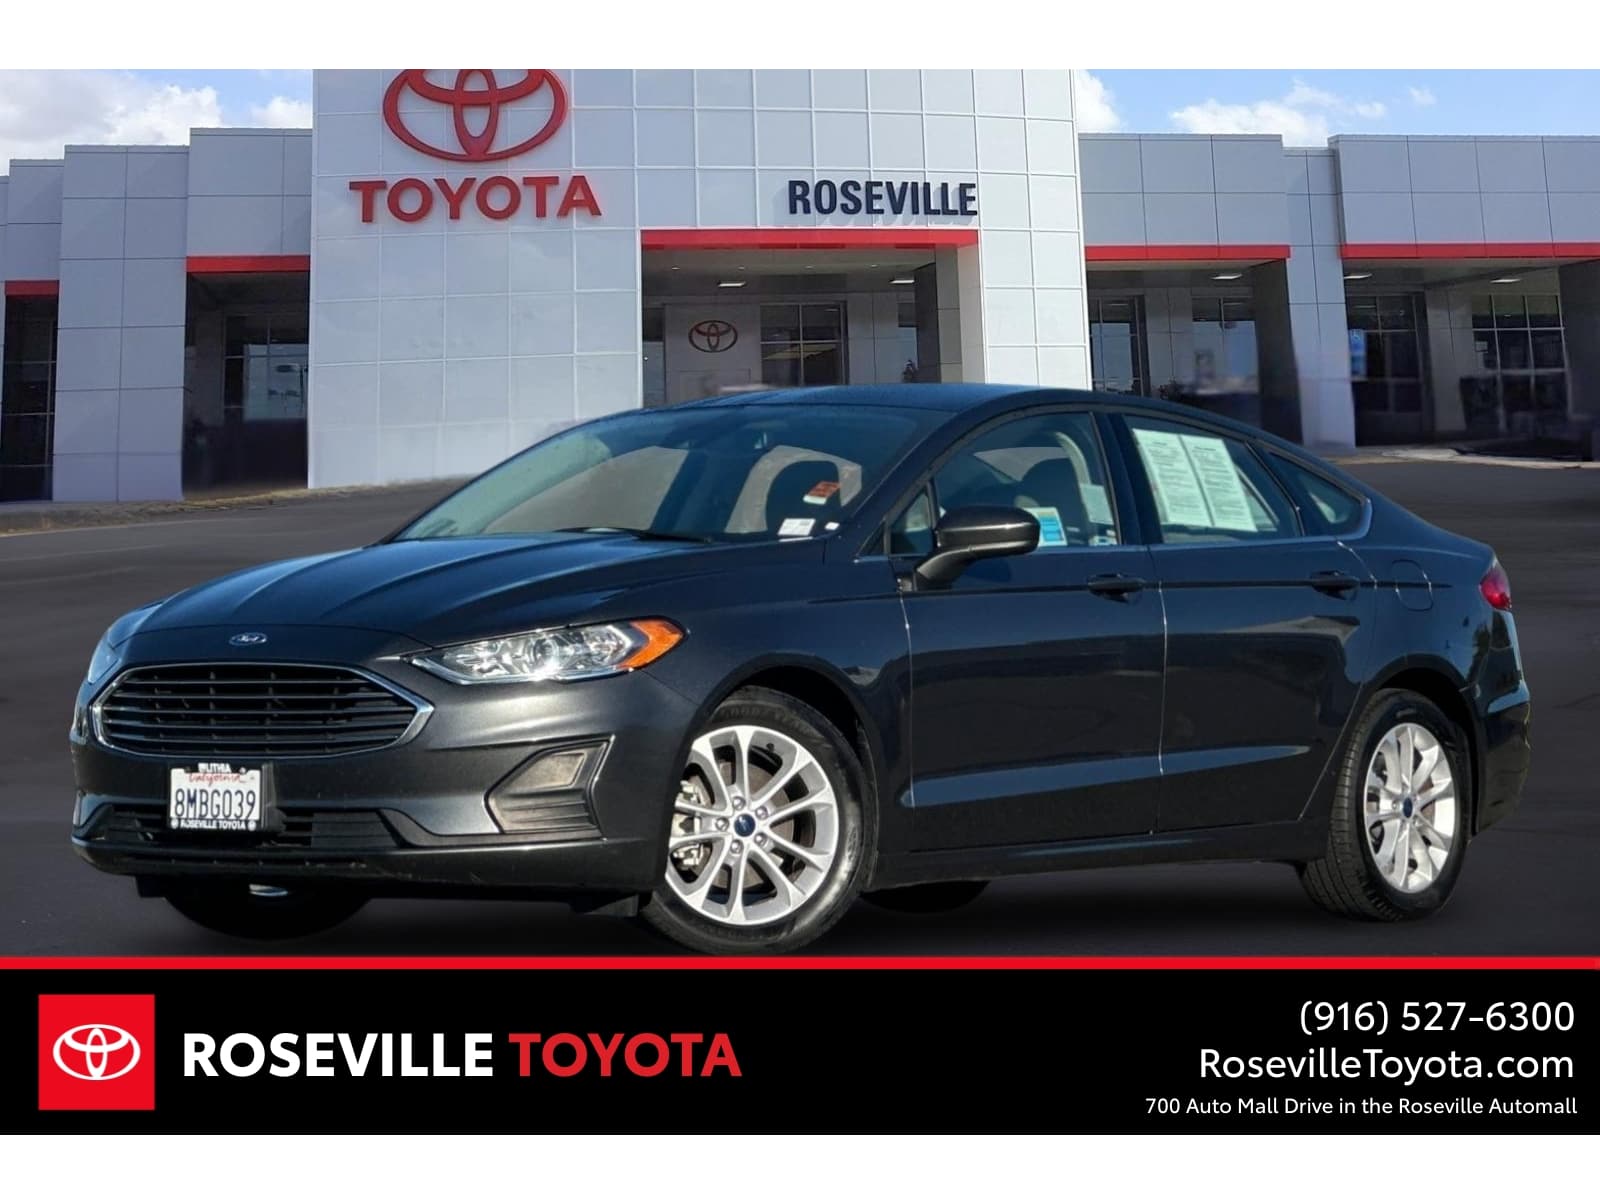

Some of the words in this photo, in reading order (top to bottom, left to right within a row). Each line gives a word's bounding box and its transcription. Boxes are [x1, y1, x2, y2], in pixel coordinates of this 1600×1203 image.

[349, 175, 602, 223] TOYOTA
[788, 181, 978, 216] ROSEVILLE
[175, 788, 256, 820] 8MBG039
[219, 820, 246, 830] TOYOTA
